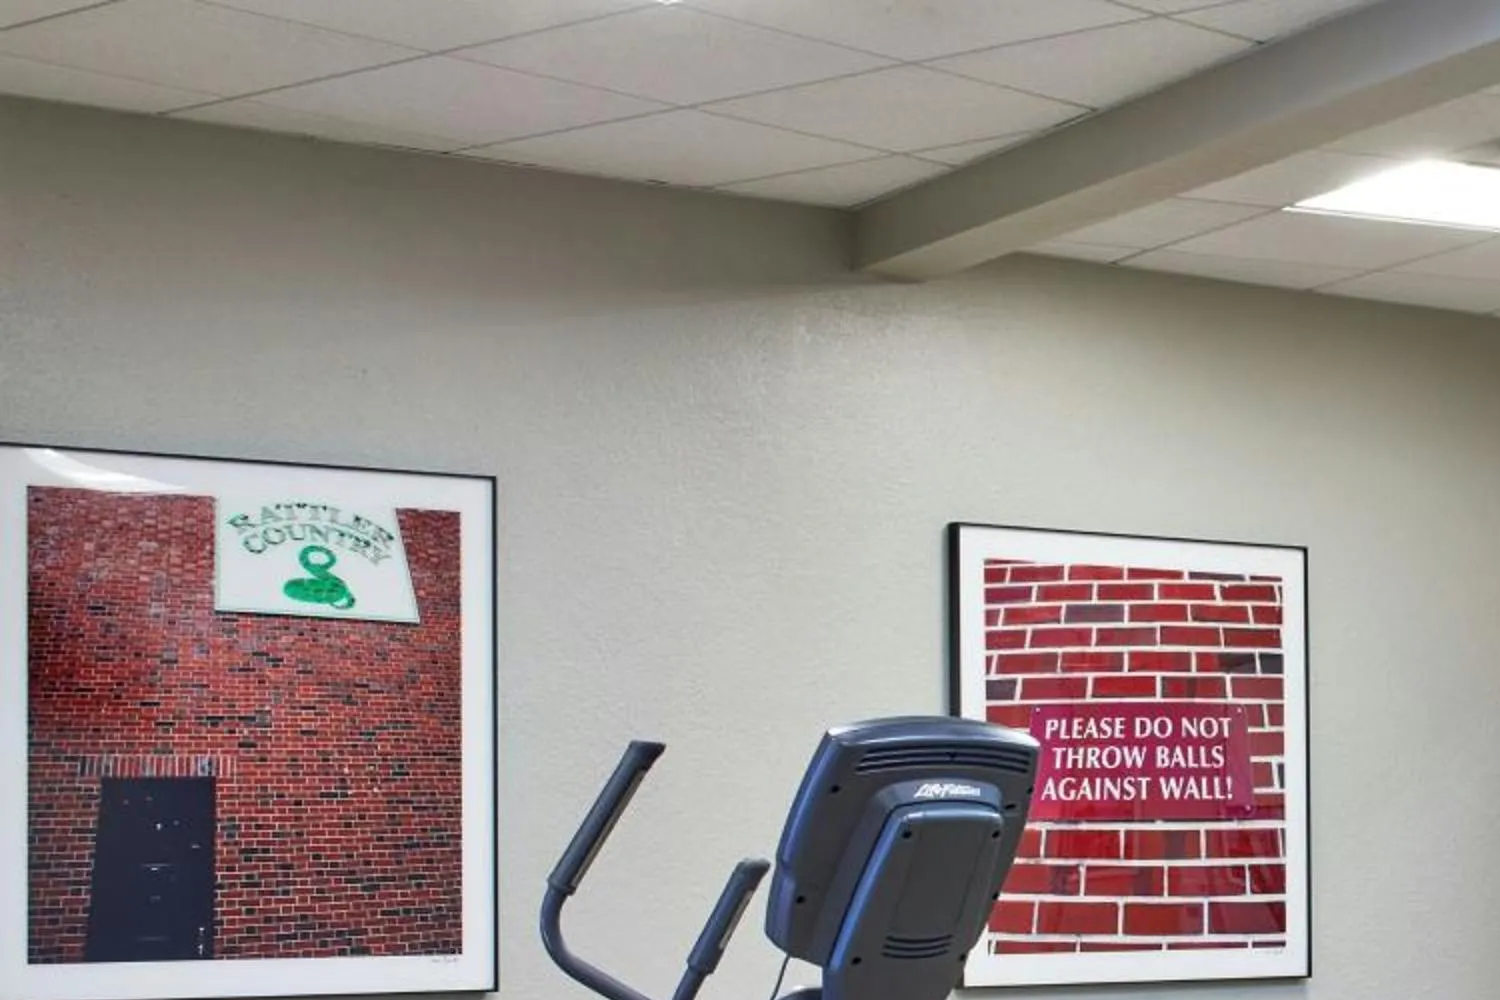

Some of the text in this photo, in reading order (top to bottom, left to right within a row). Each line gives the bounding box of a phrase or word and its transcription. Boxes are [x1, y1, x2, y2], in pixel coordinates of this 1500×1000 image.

[1045, 717, 1232, 739] PLEASE DO NOT
[1052, 745, 1225, 769] THROW BALLS
[1041, 777, 1233, 800] AGAINST WALL!
